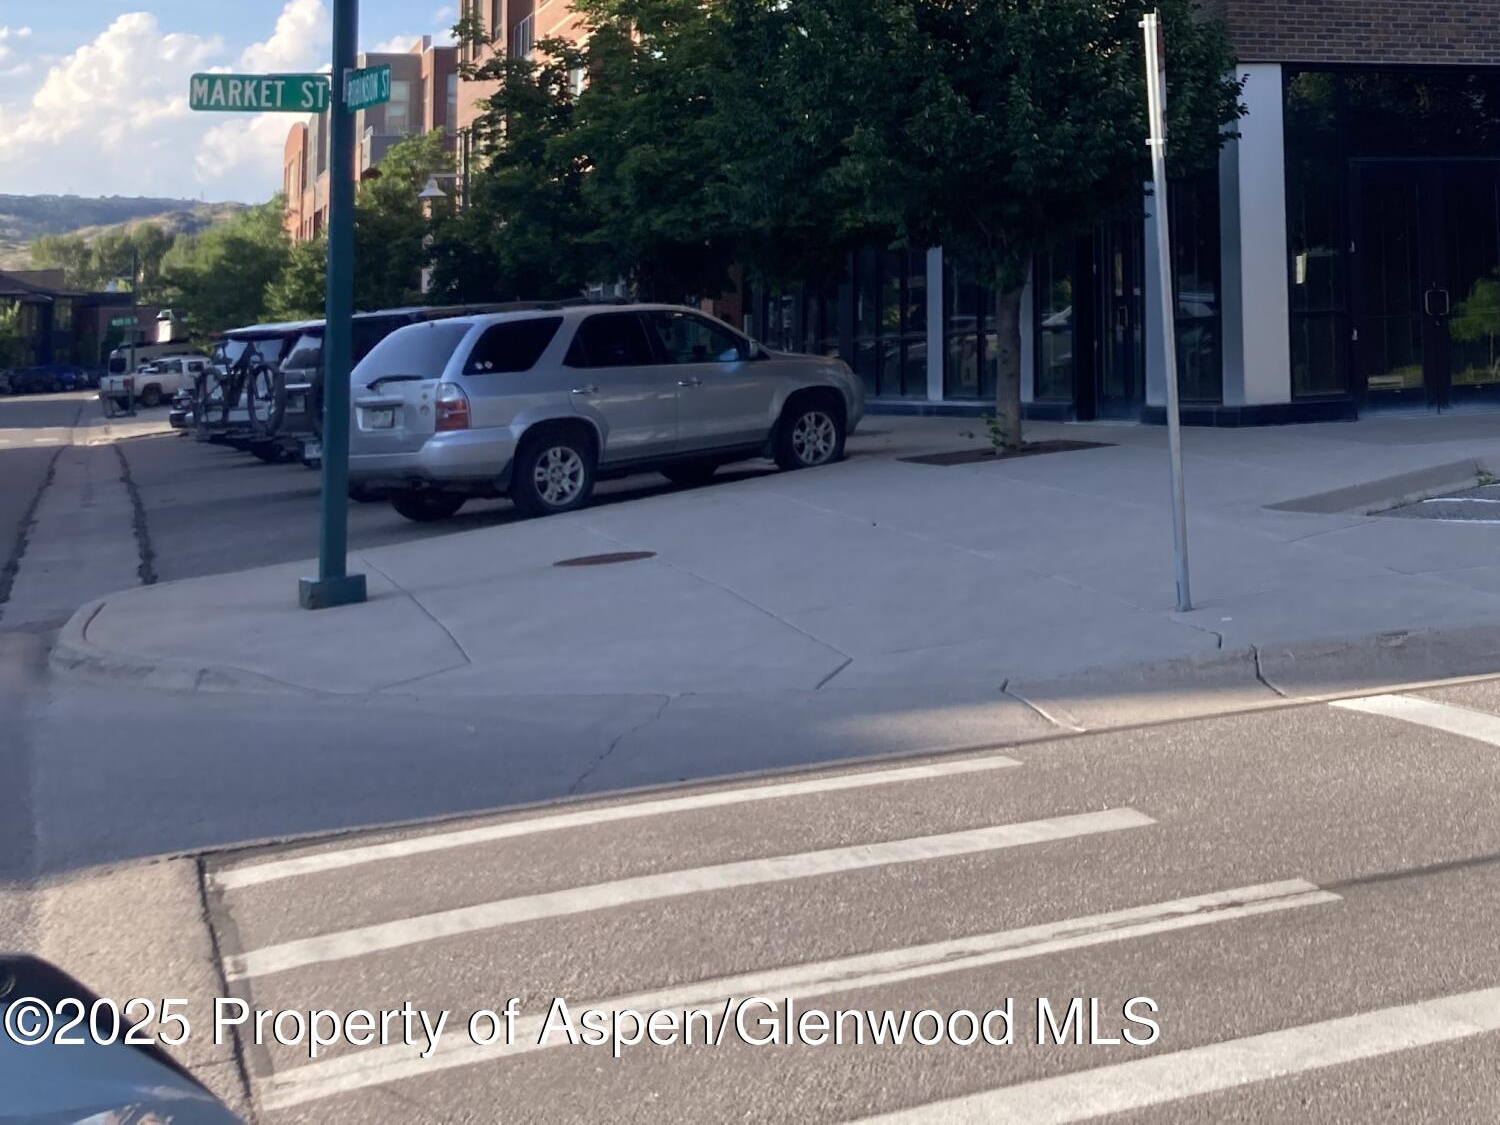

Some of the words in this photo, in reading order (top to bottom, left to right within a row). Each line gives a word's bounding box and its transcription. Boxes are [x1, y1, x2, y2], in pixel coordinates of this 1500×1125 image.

[192, 78, 286, 108] MARKET
[301, 81, 327, 108] ST
[382, 69, 390, 97] ST
